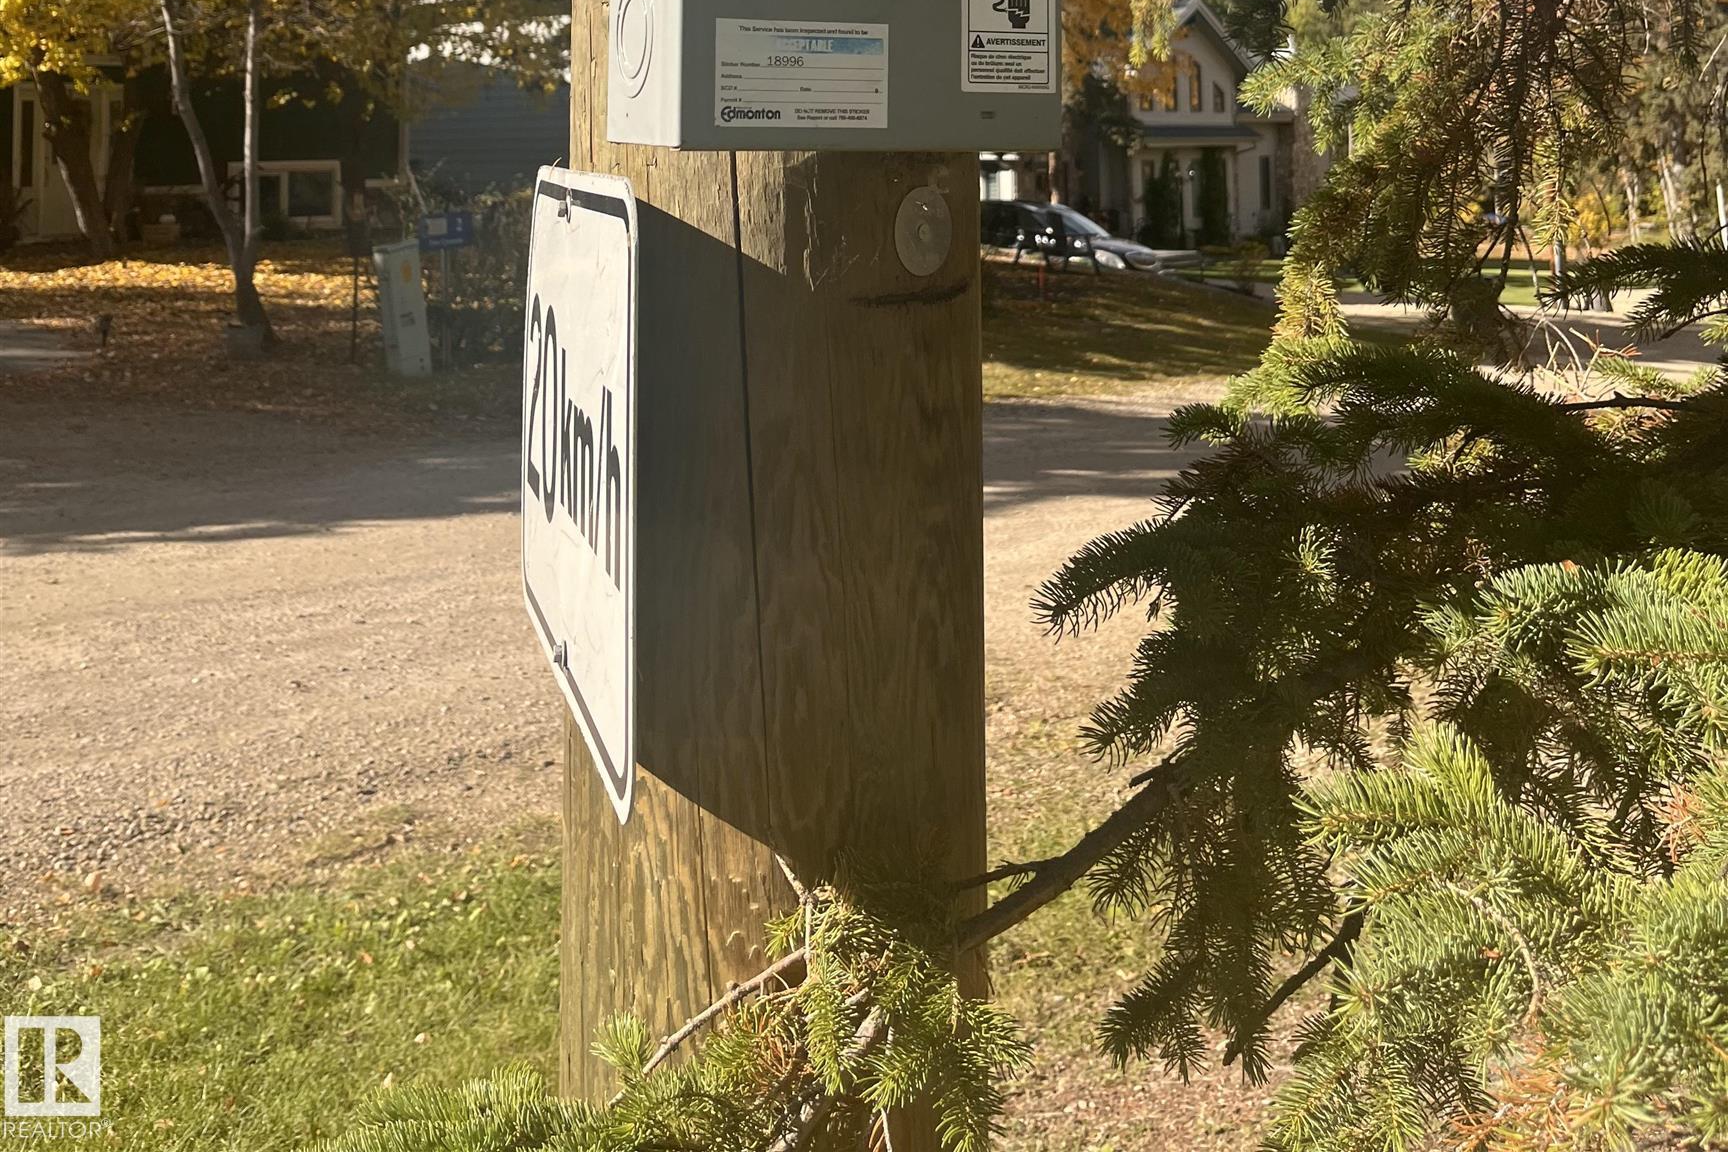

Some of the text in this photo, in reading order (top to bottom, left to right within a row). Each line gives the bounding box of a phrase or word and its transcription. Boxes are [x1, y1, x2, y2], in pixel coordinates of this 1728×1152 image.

[986, 37, 1046, 47] AVERTISSEMENT
[767, 55, 804, 67] 18996
[721, 106, 781, 123] Edmonton
